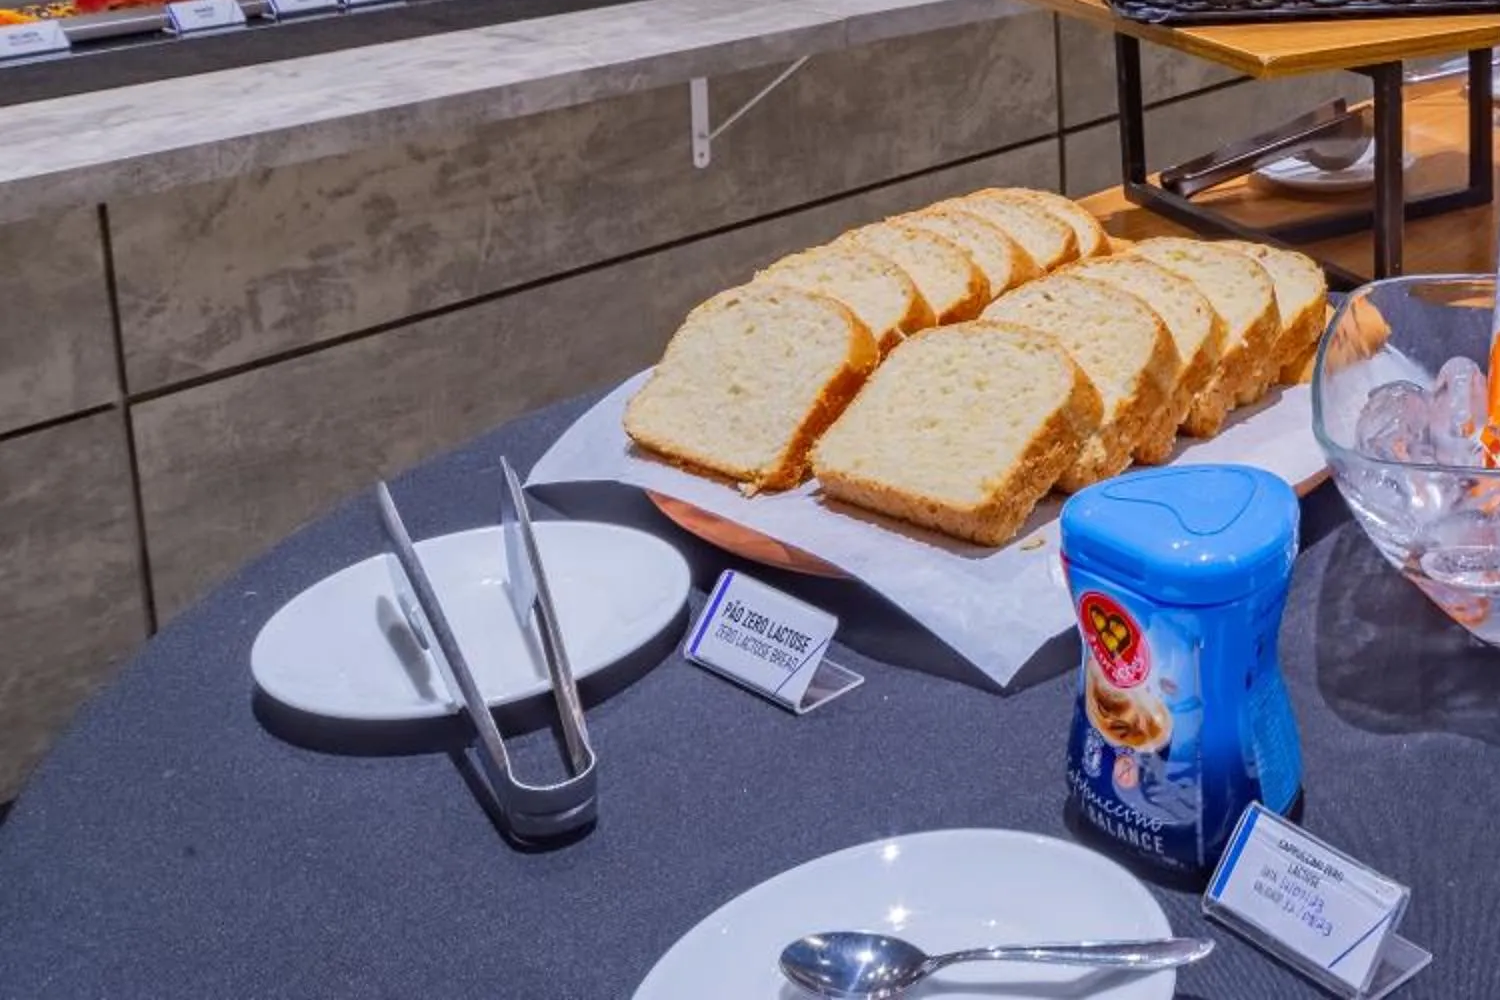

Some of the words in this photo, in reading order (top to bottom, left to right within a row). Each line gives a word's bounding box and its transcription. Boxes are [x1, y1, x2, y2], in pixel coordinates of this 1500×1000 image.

[721, 600, 745, 623] PÃO
[741, 610, 769, 638] ZERO
[766, 621, 812, 655] LACTOSE
